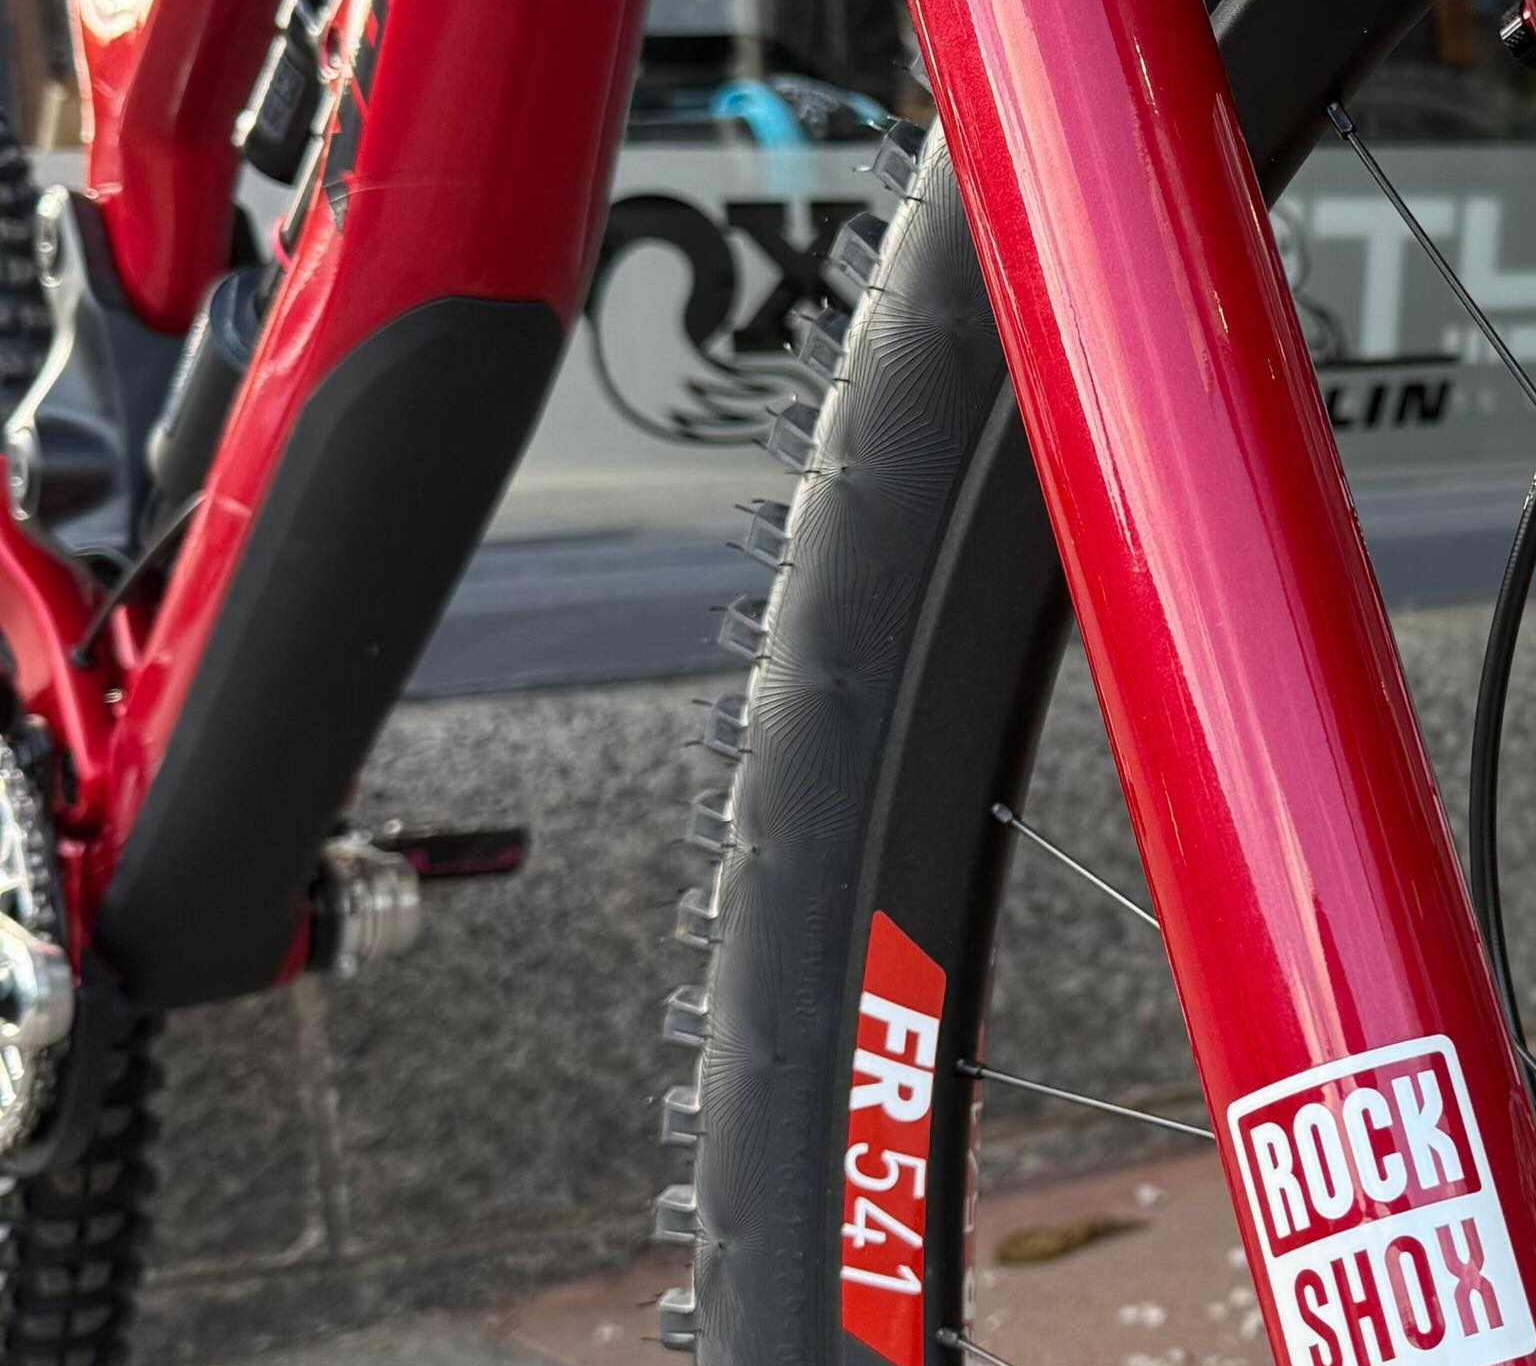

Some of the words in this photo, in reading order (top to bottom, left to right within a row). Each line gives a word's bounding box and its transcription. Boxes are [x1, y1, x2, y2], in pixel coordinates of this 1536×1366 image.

[848, 991, 941, 1125] FR
[840, 1142, 927, 1297] 541
[1249, 1068, 1466, 1240] ROCK
